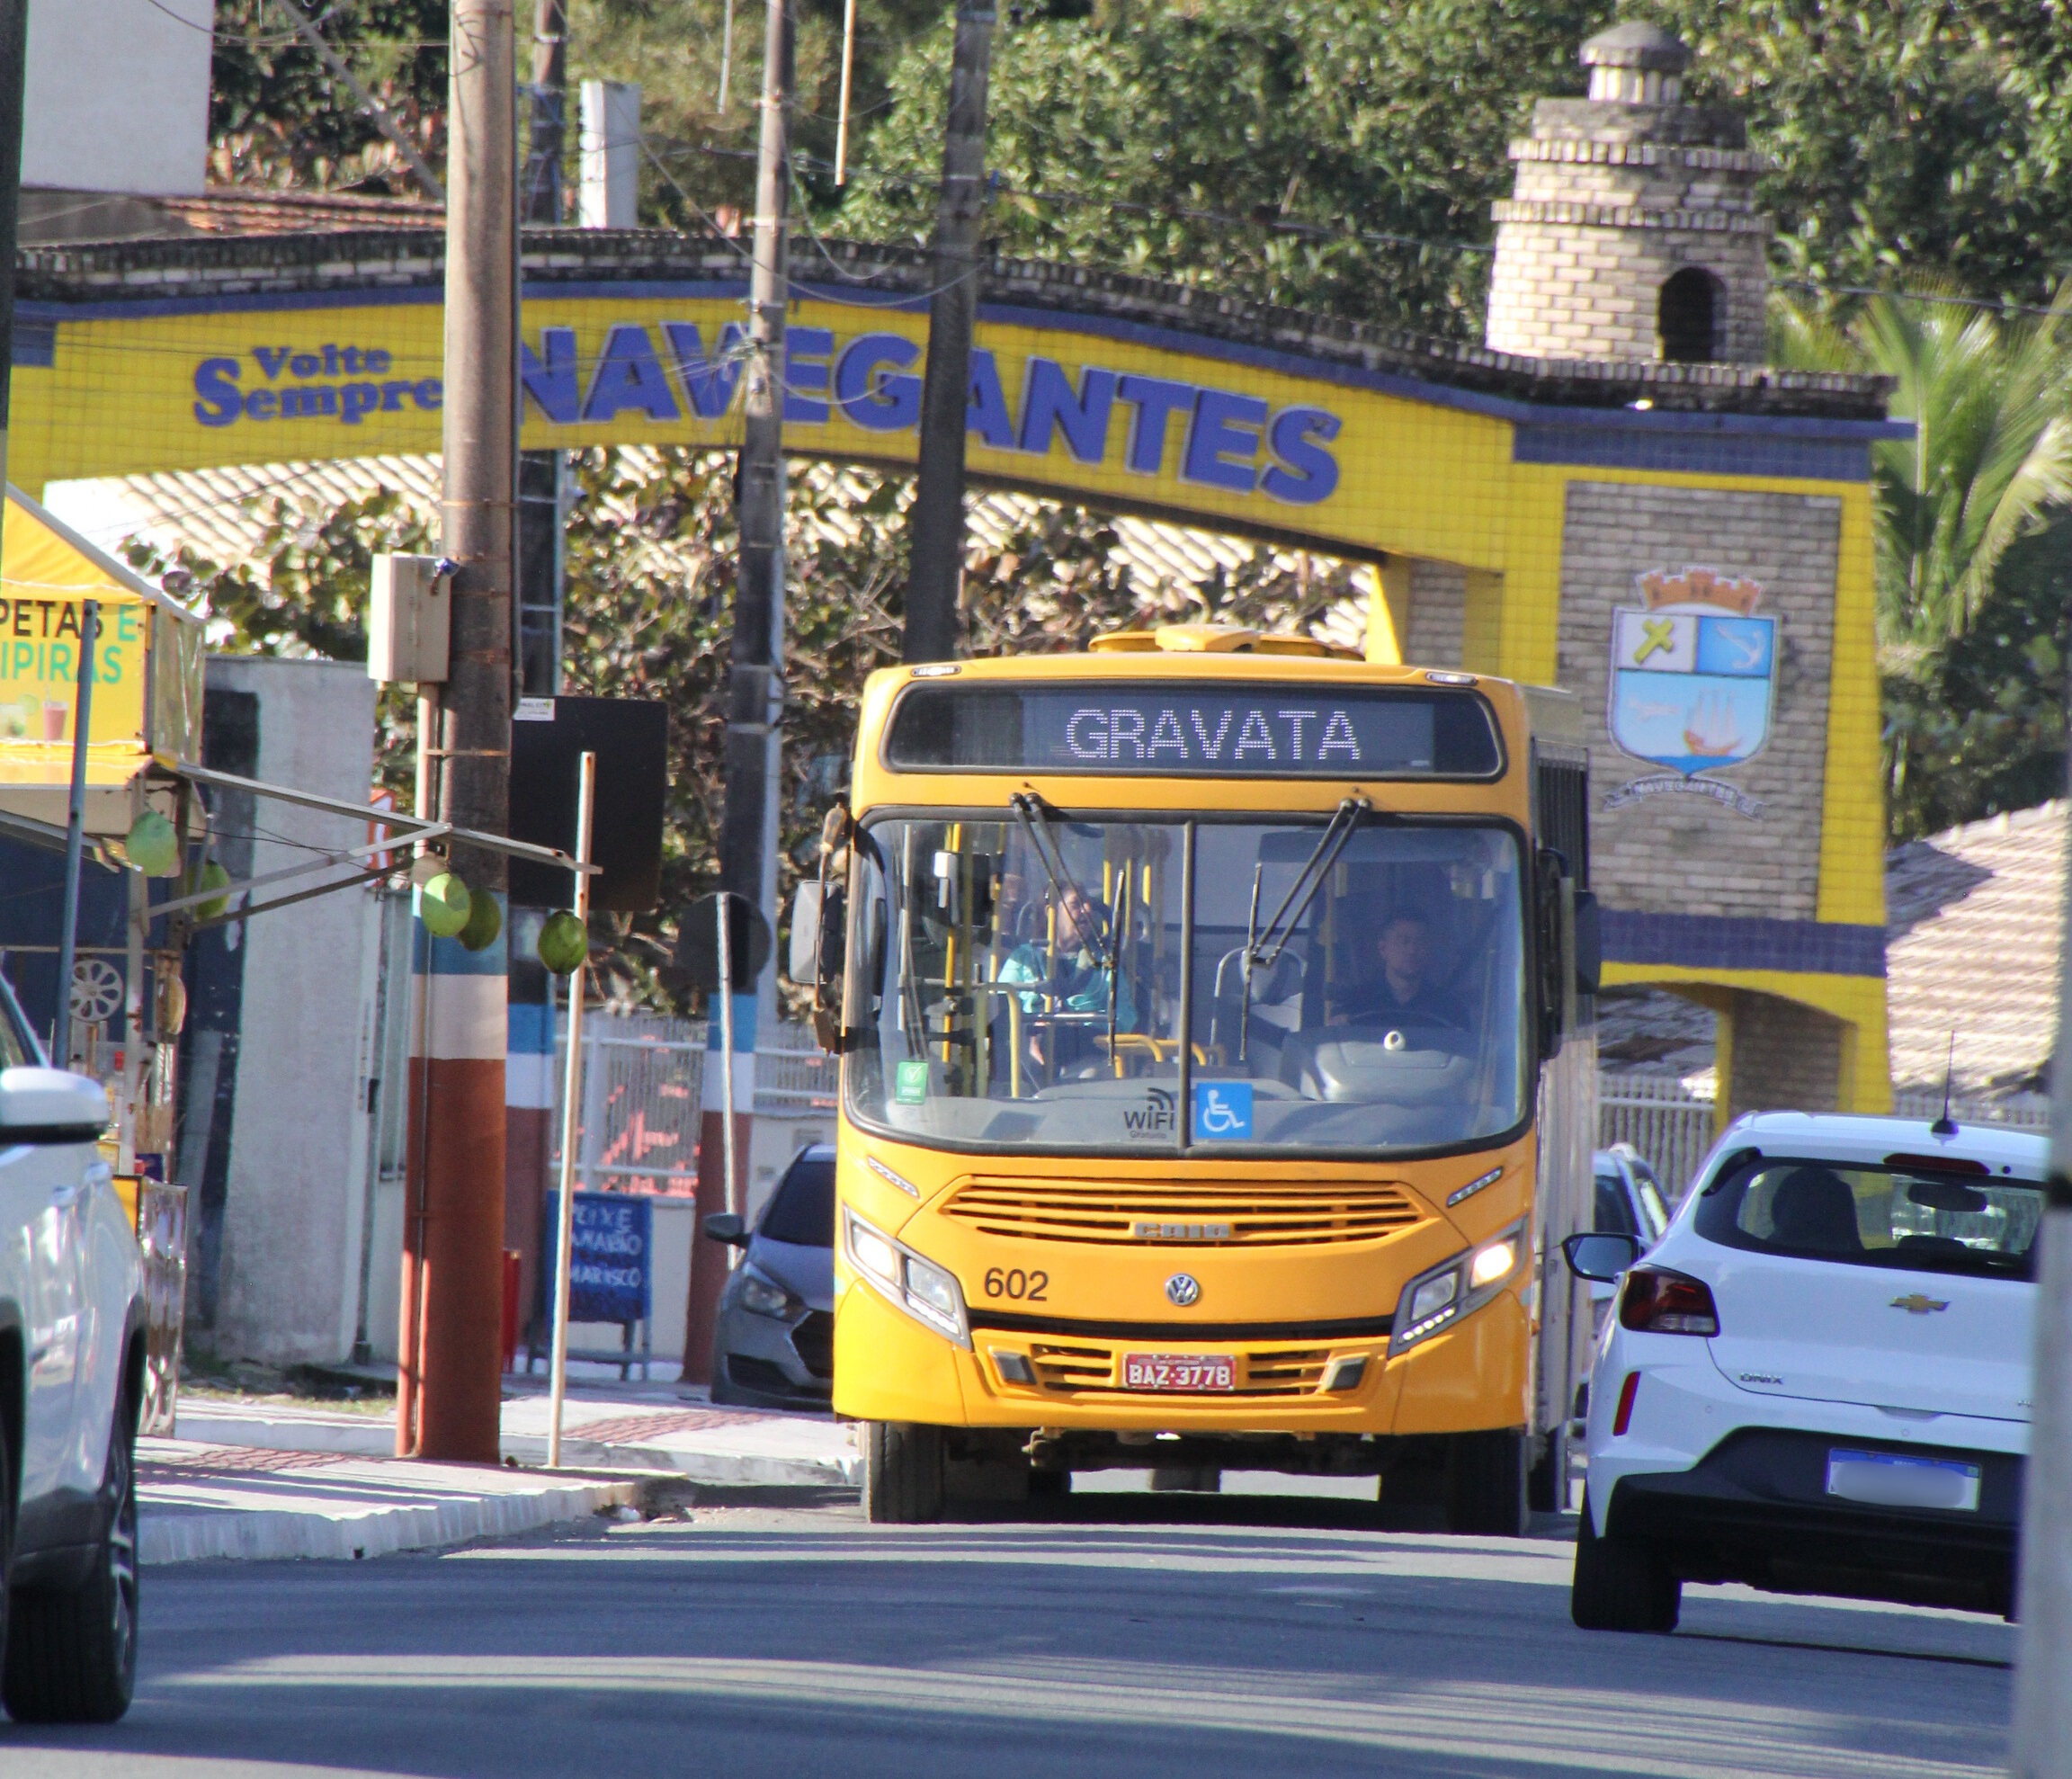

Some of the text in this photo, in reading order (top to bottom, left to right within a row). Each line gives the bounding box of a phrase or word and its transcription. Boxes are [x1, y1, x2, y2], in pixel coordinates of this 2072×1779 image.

[253, 343, 392, 381] Volte
[193, 356, 443, 427] Sempre
[119, 605, 137, 641] E
[1, 641, 122, 684] IPIRS
[1067, 709, 1361, 760] GRAVATA
[984, 1266, 1049, 1301] 602
